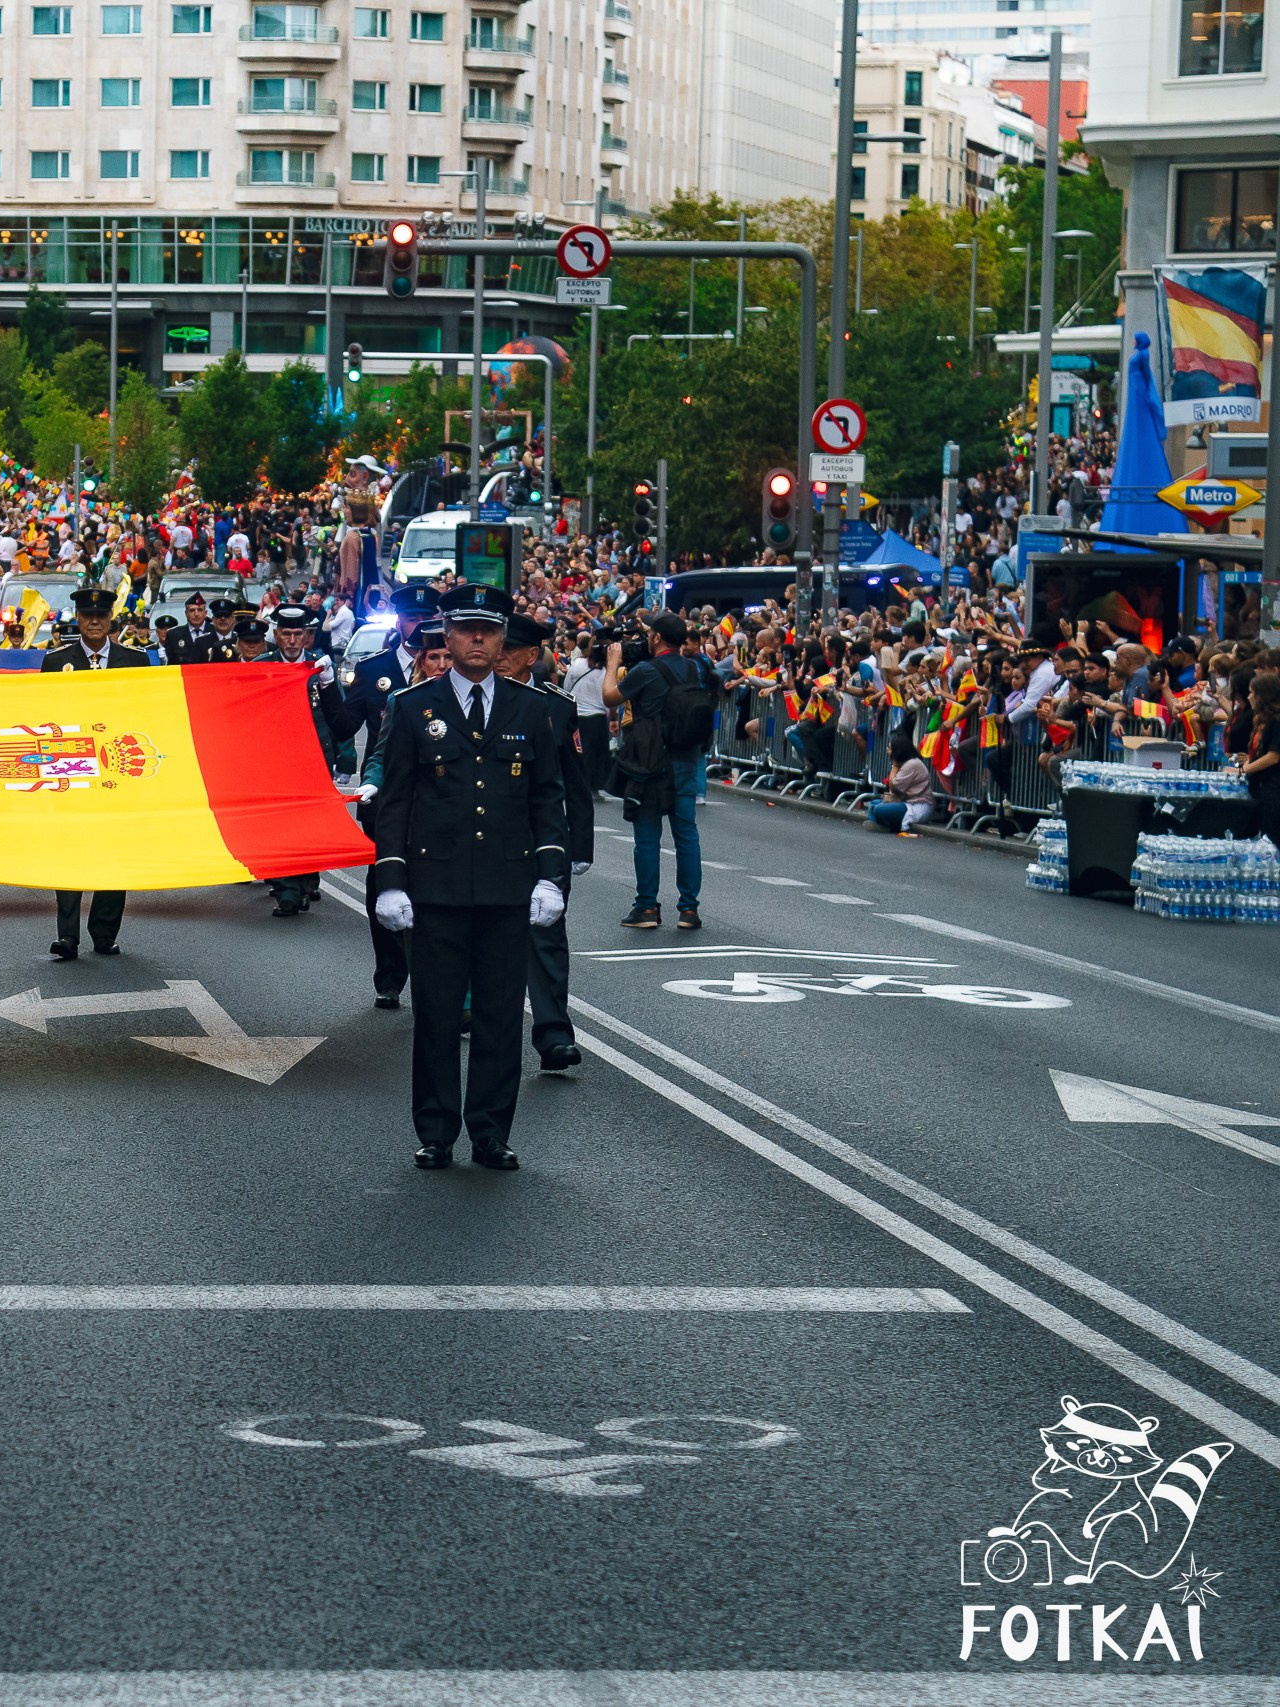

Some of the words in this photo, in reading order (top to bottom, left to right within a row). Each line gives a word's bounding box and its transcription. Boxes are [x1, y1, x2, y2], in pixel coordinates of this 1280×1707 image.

[445, 222, 495, 237] ADRD
[1208, 404, 1253, 418] MADRID
[1190, 488, 1233, 503] Metro
